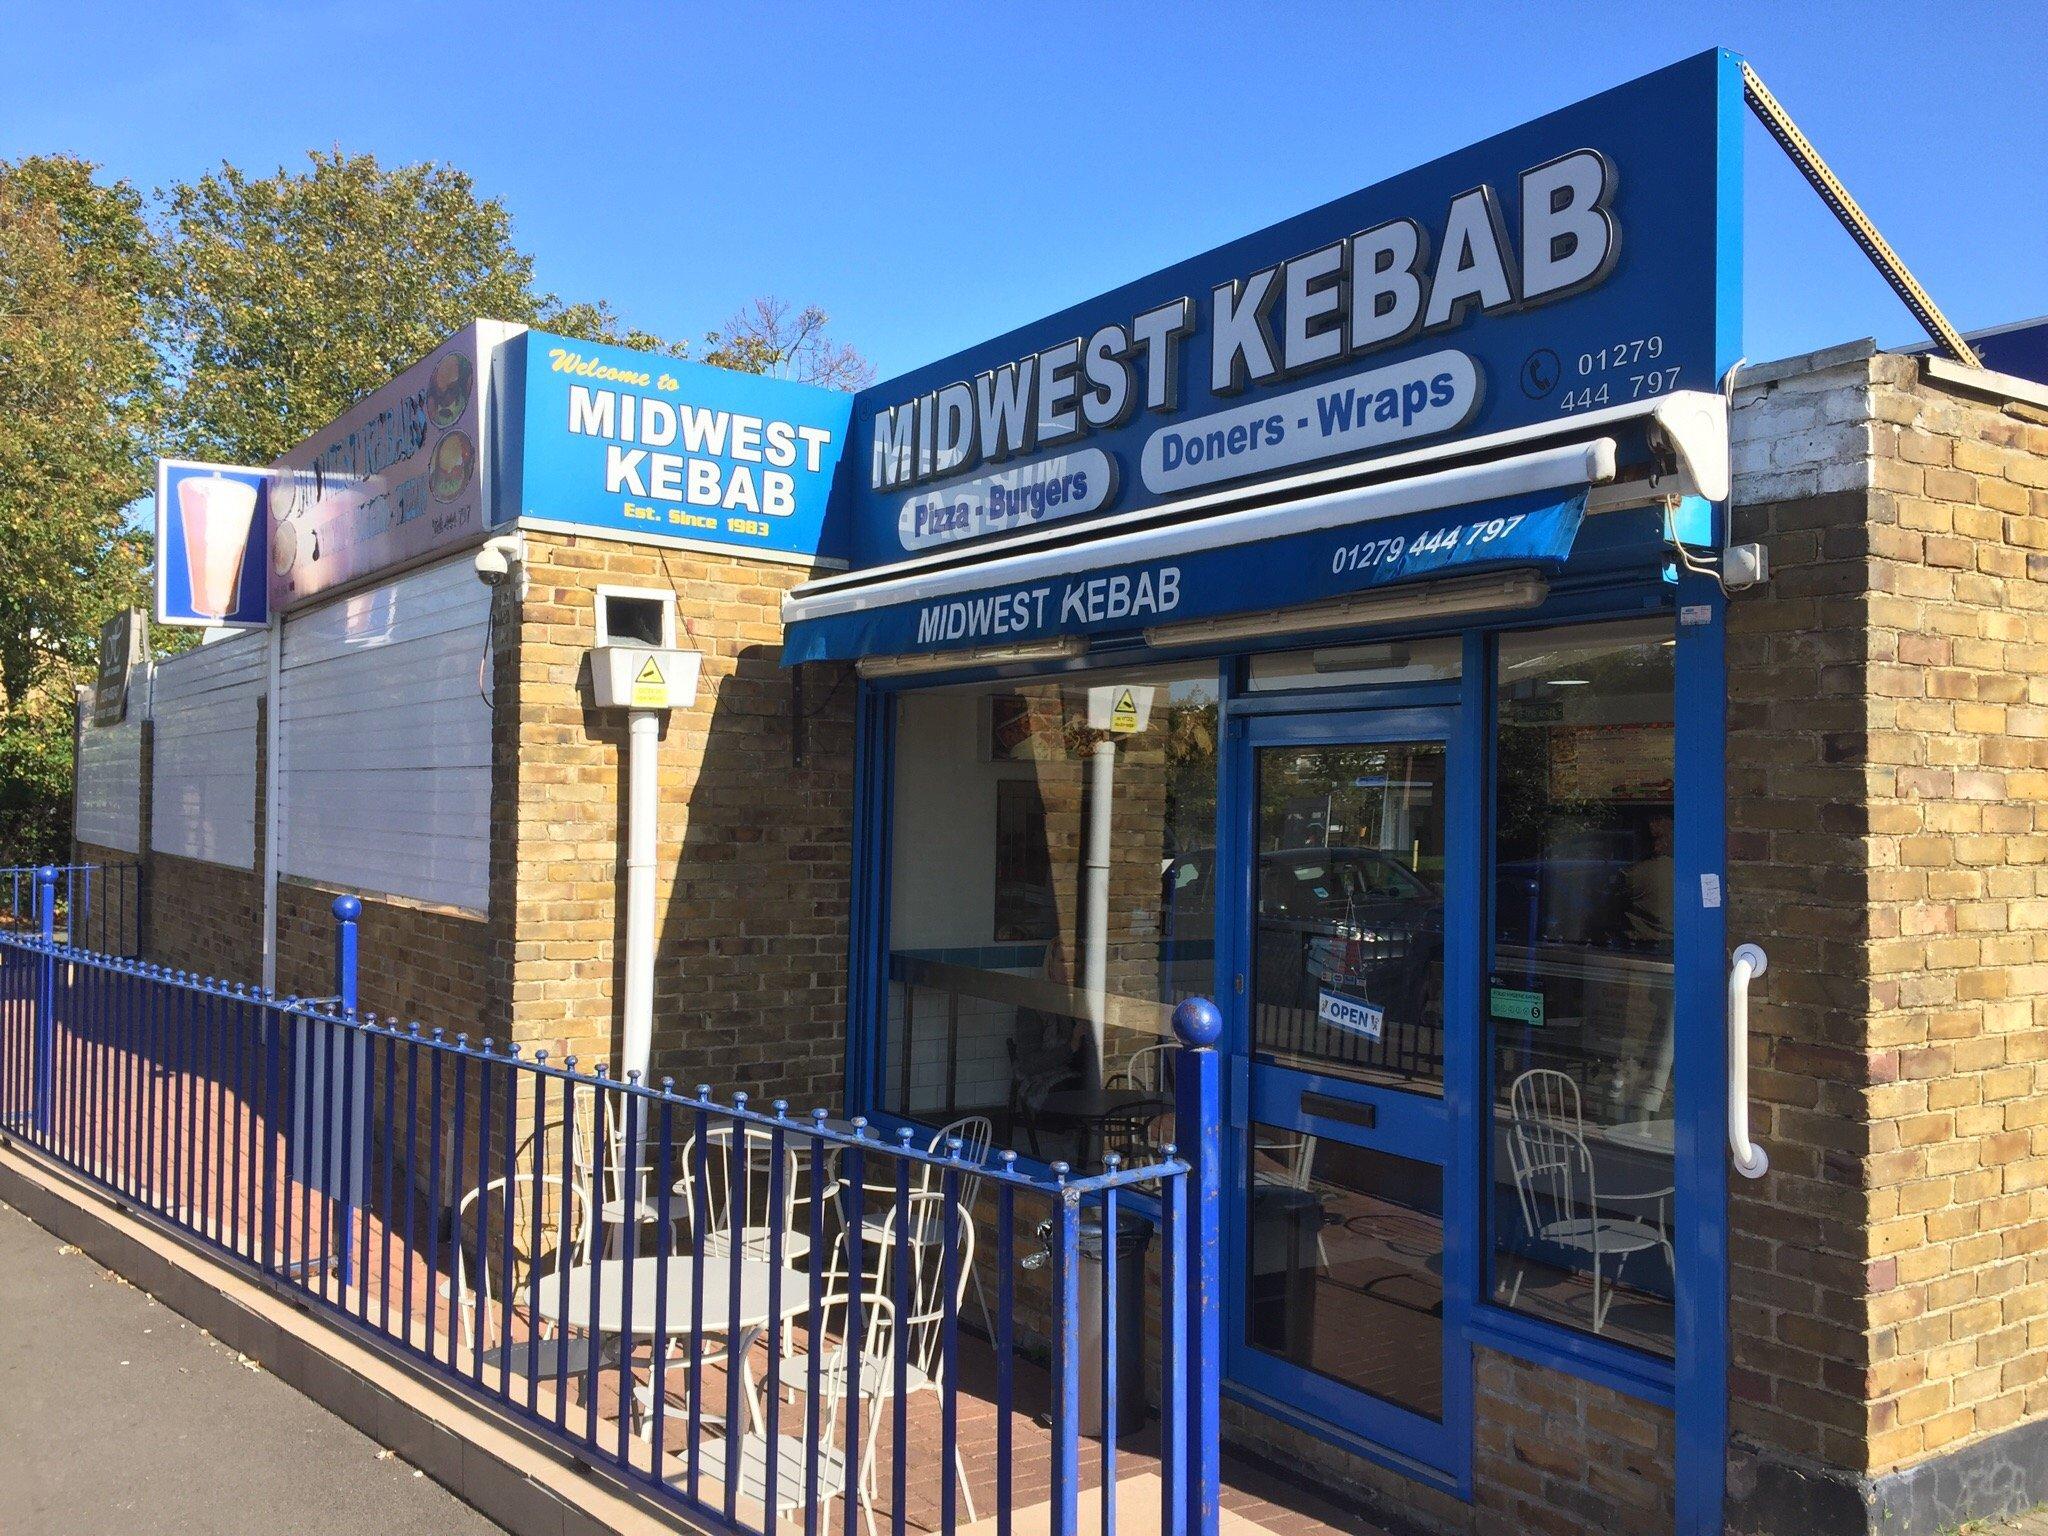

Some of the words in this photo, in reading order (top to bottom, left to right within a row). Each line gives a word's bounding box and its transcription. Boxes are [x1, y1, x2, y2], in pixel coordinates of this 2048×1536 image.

[872, 296, 1192, 491] MIDWEST
[1211, 148, 1616, 394] KEBAB
[549, 348, 650, 387] Welcome
[657, 373, 680, 392] to
[1578, 336, 1663, 376] 01279
[1560, 383, 1610, 412] 444
[1629, 366, 1682, 398] 797
[568, 384, 831, 473] MIDWEST
[1161, 413, 1285, 472] Doners
[1316, 373, 1456, 439] Wraps
[605, 446, 796, 518] KEBAB
[914, 499, 969, 538] Pizza
[990, 471, 1088, 521] Burgers
[624, 502, 661, 523] Est.
[668, 509, 717, 531] Since
[727, 518, 770, 538] 1983
[1332, 536, 1405, 574] 01279
[1409, 525, 1463, 557] 444
[1466, 514, 1526, 546] 797
[917, 587, 1050, 645] MIDWEST
[1060, 566, 1181, 624] KEBAB
[1330, 1002, 1369, 1028] OPEN
